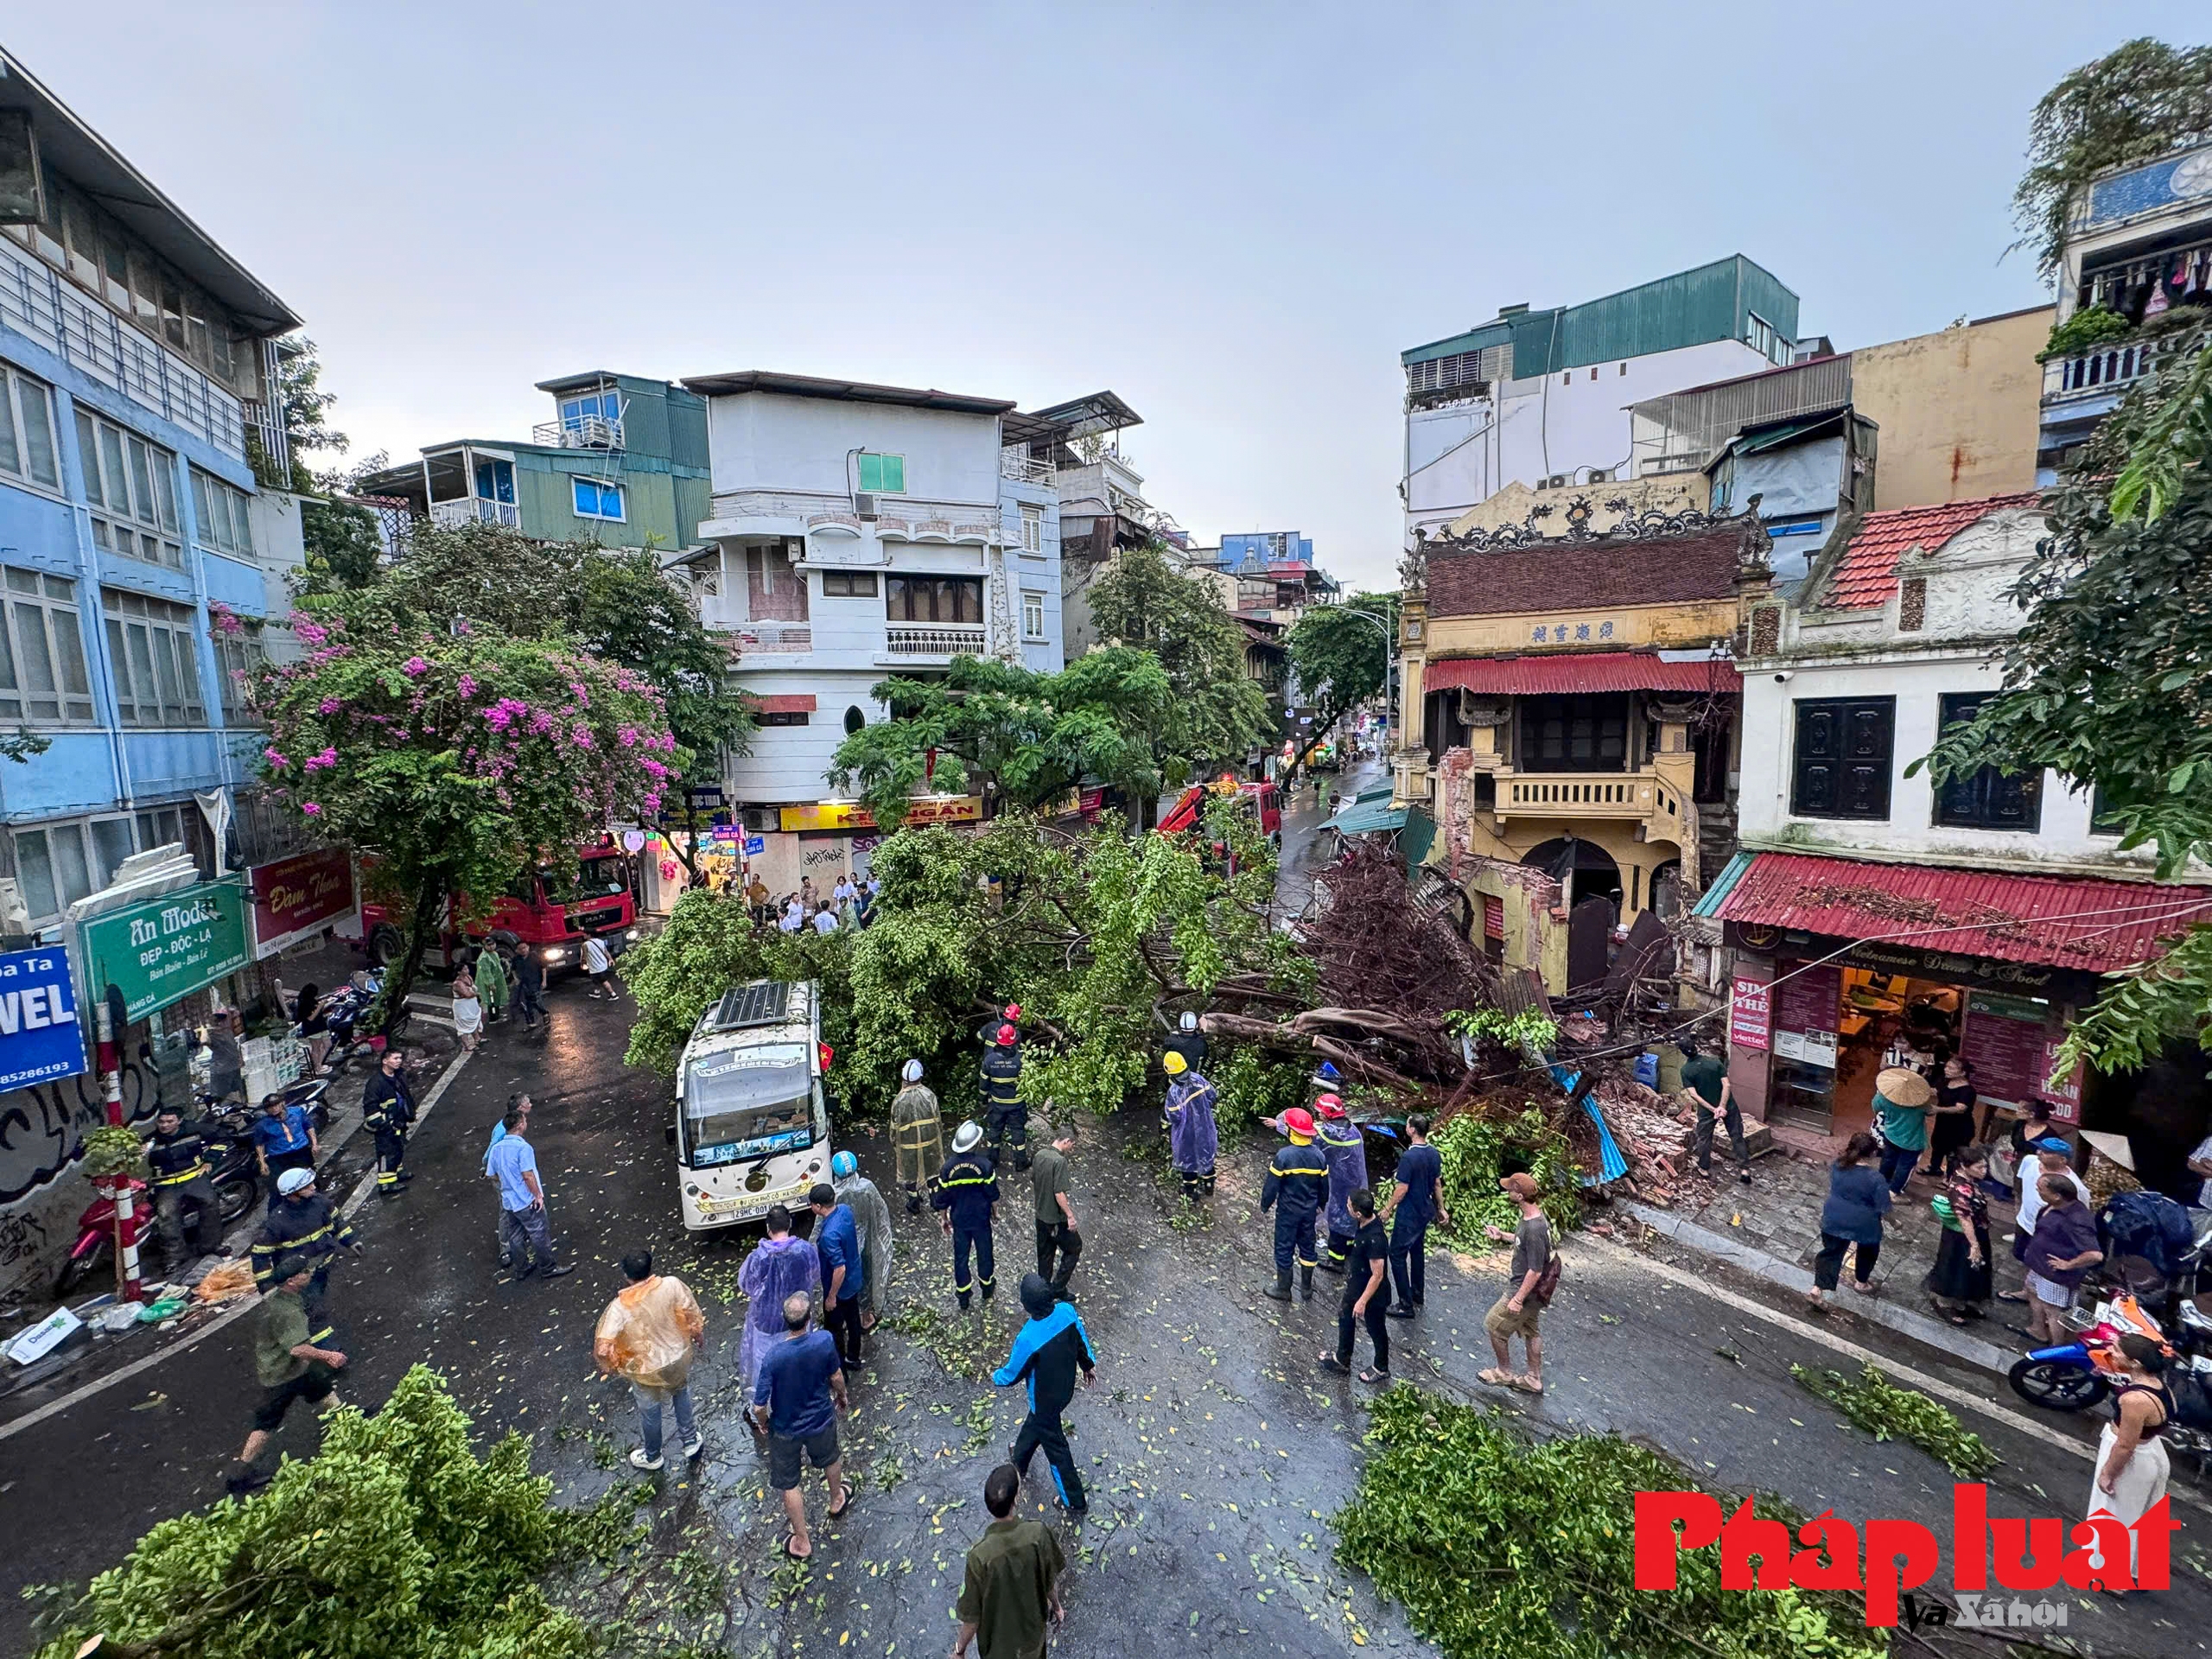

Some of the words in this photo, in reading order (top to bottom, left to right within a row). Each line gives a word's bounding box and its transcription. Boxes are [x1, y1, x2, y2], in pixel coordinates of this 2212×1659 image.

[140, 946, 162, 968] ĐẸP
[170, 935, 193, 955] ĐỘC
[23, 957, 54, 974] Ta
